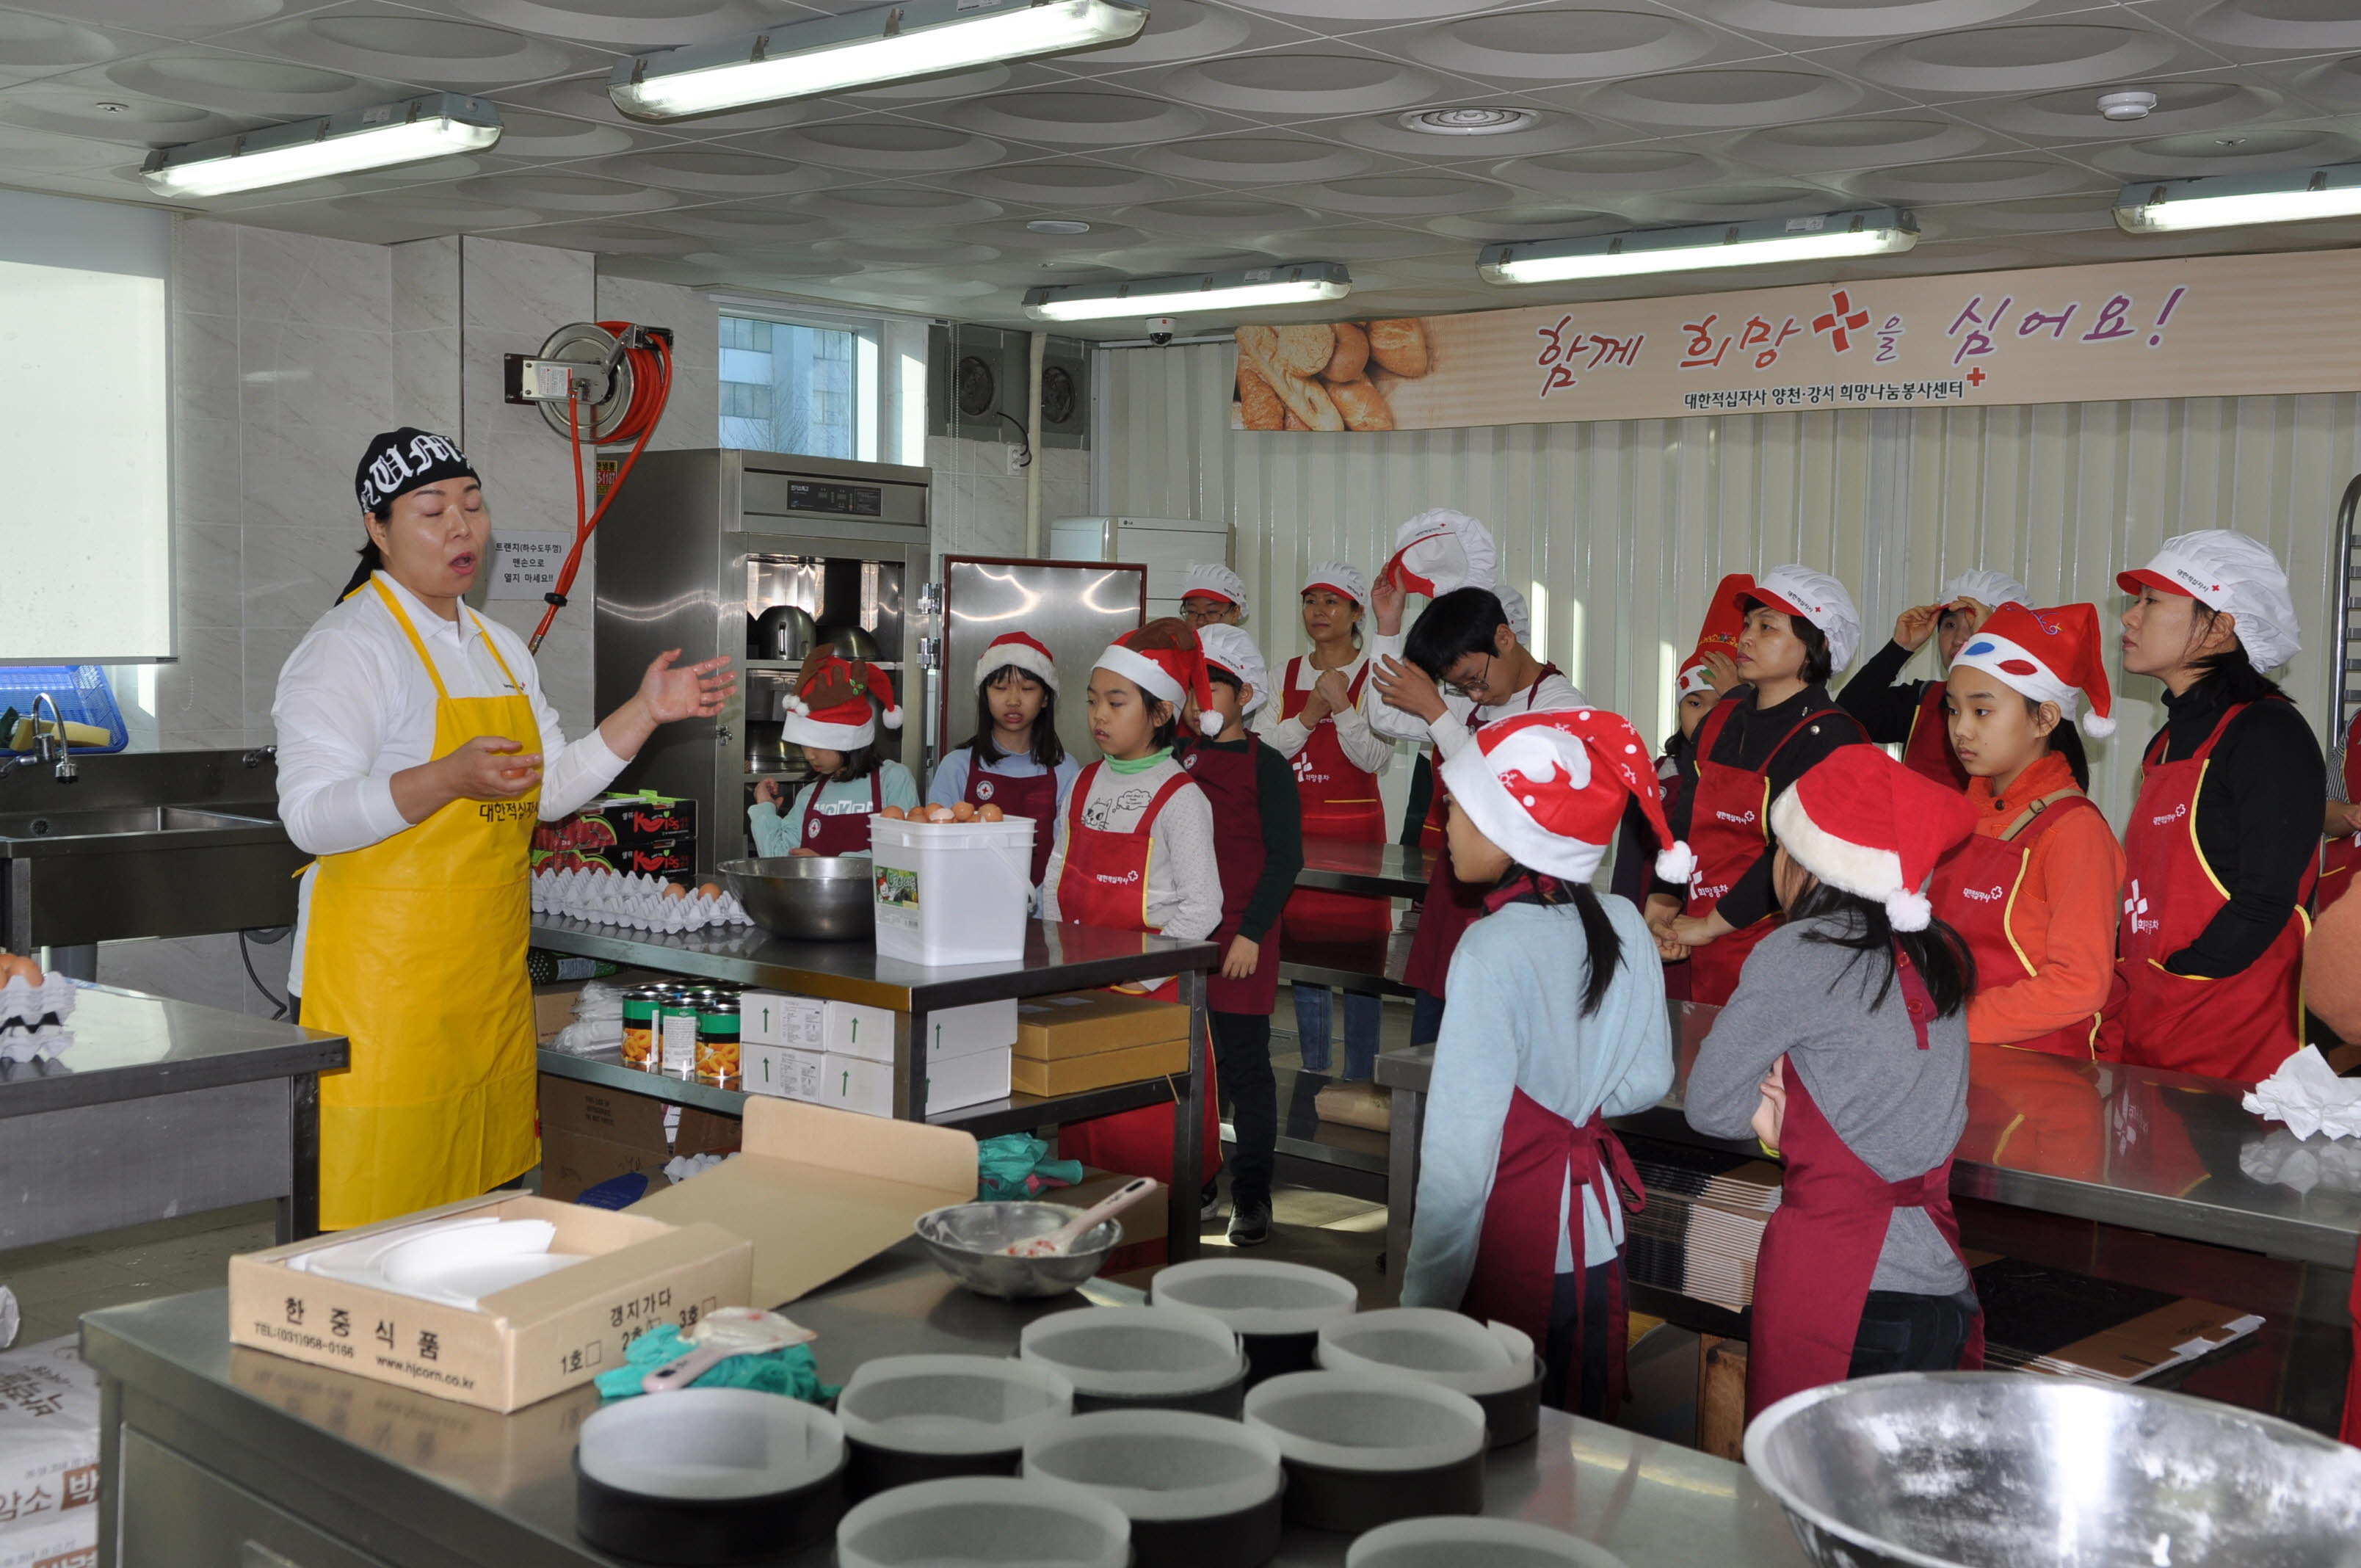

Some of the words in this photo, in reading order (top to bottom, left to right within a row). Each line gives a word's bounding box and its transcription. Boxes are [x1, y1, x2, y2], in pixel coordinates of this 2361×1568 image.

[1539, 316, 1644, 397] 함께
[1680, 315, 1801, 368] 희망
[1875, 316, 1903, 361] 을
[1948, 288, 2186, 364] 심어요!
[1684, 389, 1767, 410] 대한적십자사
[1772, 385, 1835, 404] 양천·강서
[1840, 381, 1965, 402] 희망나눔봉사센터
[512, 558, 545, 567] 맨손으로
[504, 573, 520, 583] 열지
[524, 573, 554, 583] 마세요!!
[2177, 569, 2209, 592] 대한적십자사
[1697, 884, 1729, 898] 희망풍차
[610, 1287, 672, 1327] 갱지가다
[679, 1305, 699, 1329] 3호
[561, 1350, 583, 1374] 1호
